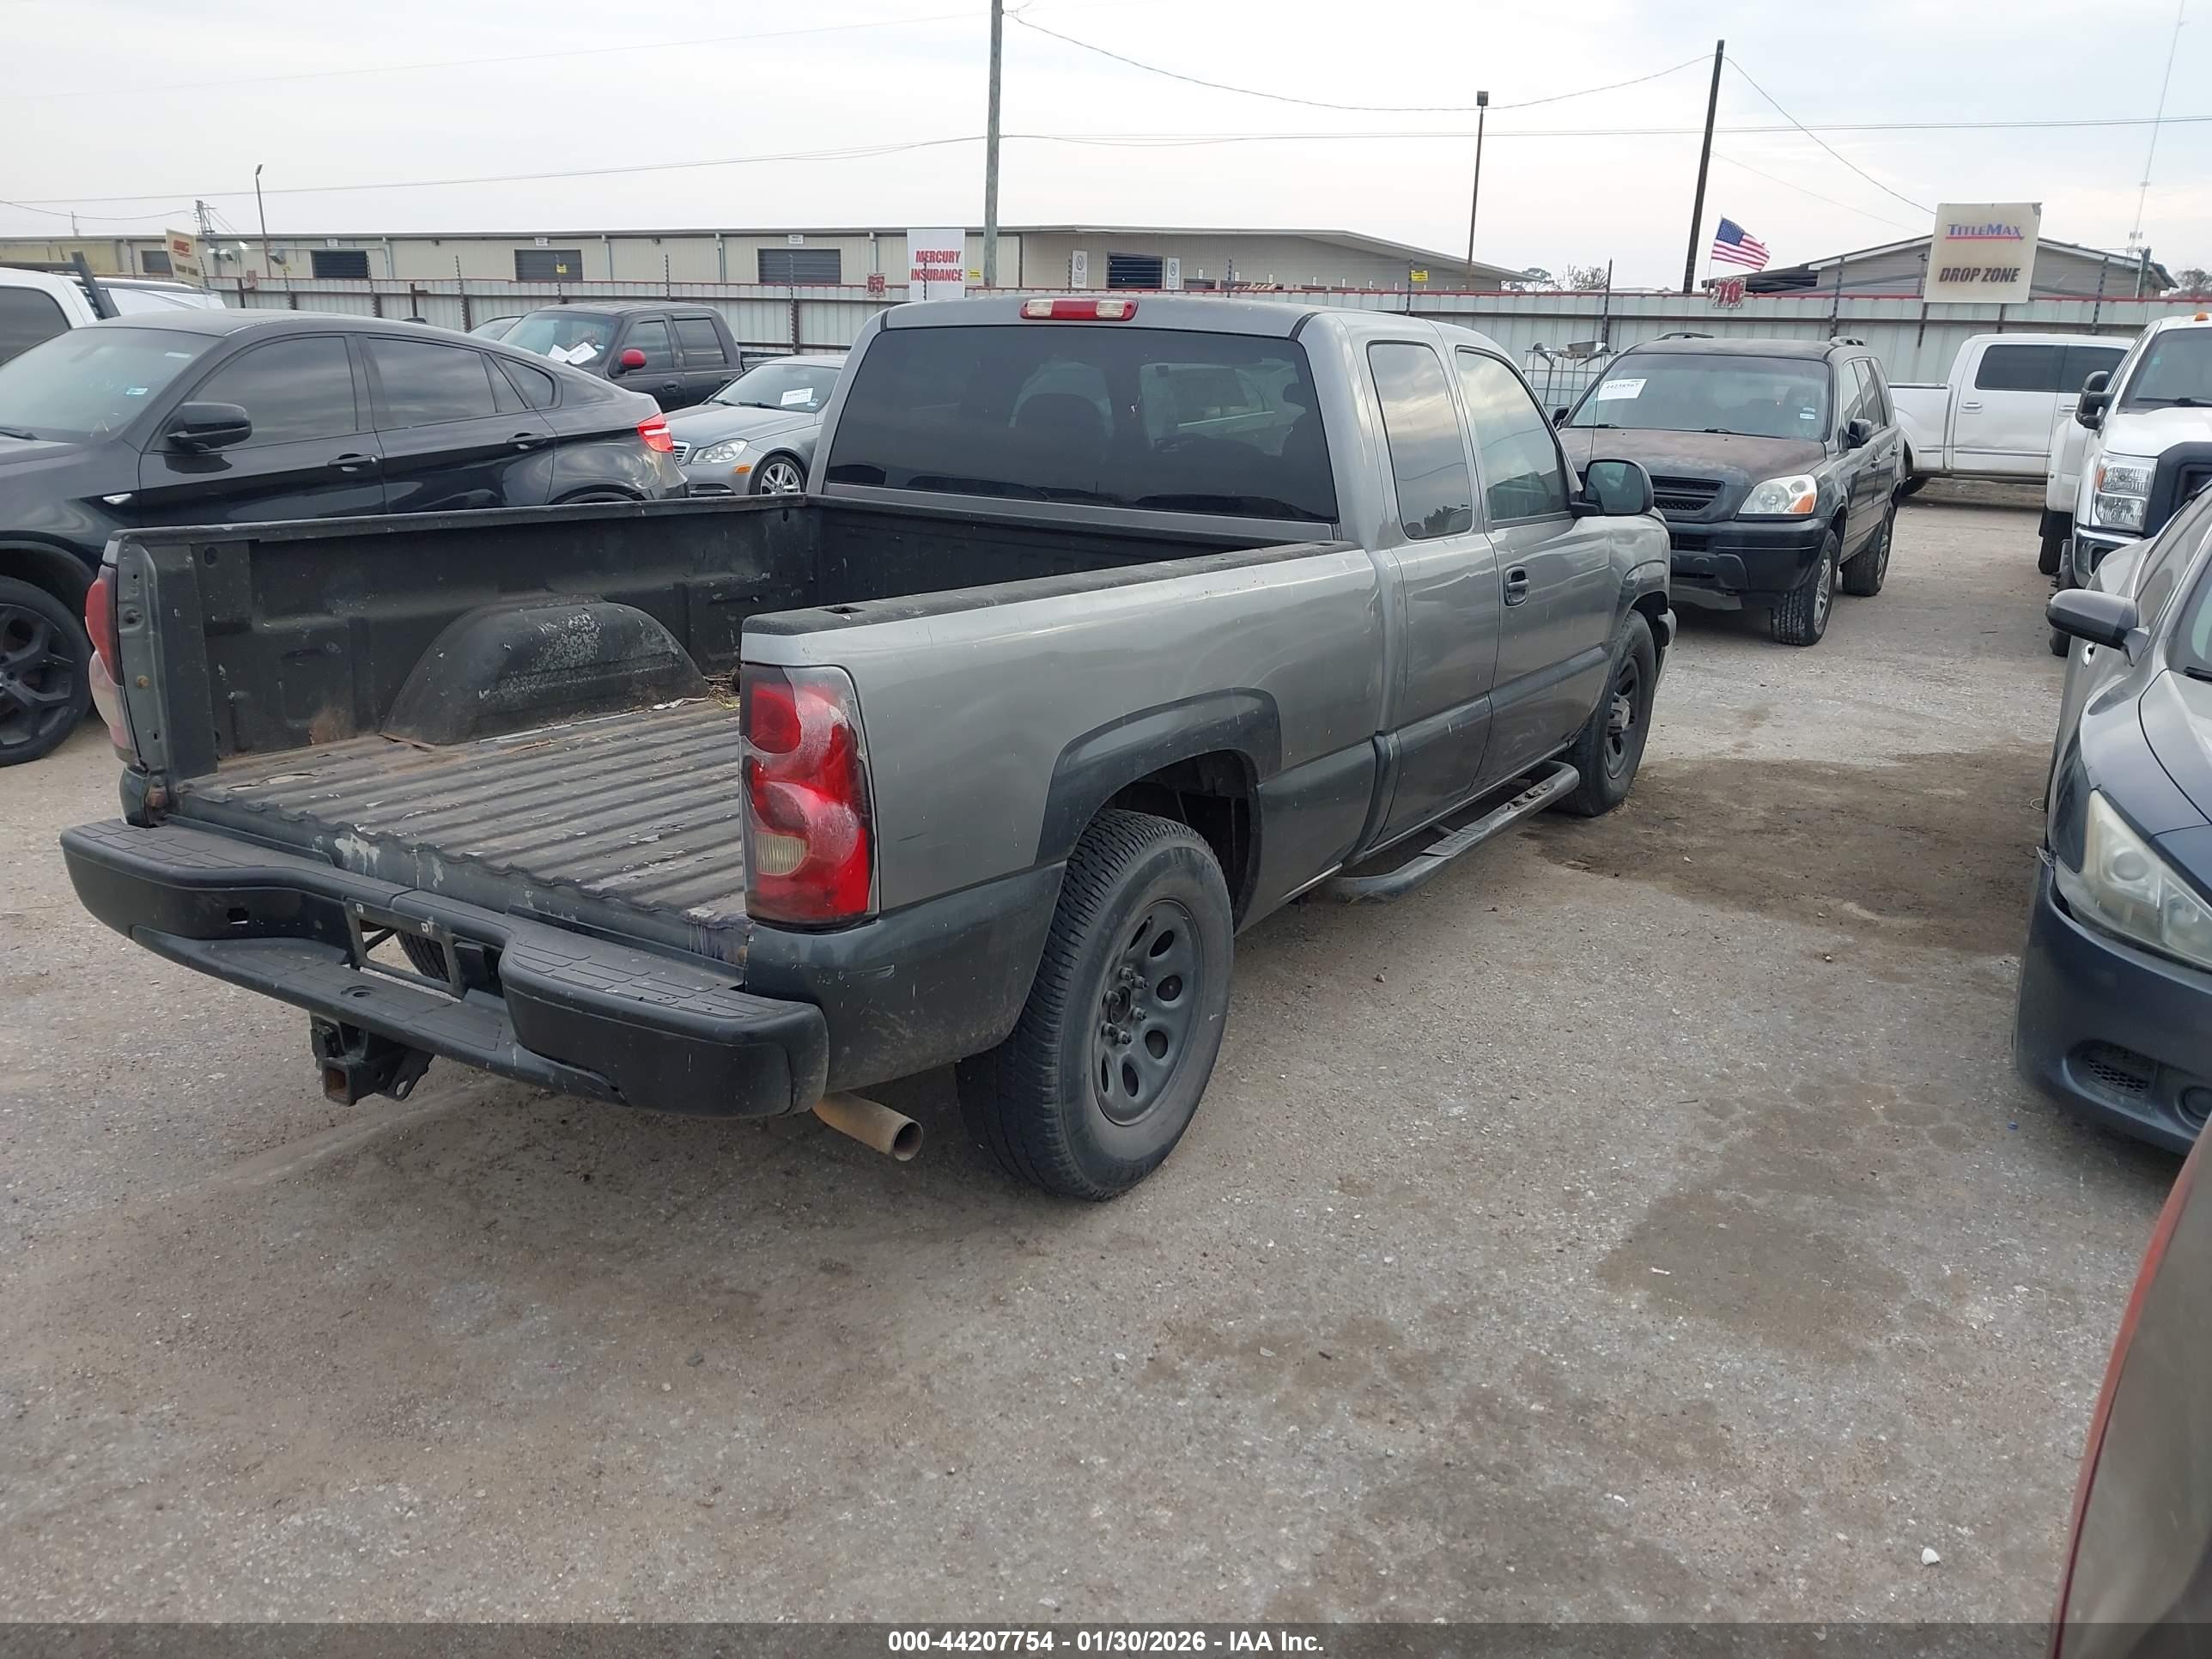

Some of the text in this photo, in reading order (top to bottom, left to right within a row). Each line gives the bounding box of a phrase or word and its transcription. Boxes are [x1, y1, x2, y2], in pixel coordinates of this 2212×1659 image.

[915, 250, 962, 264] MERCURY
[910, 267, 963, 282] INSURANCE
[1939, 267, 2021, 283] DROP ZONE
